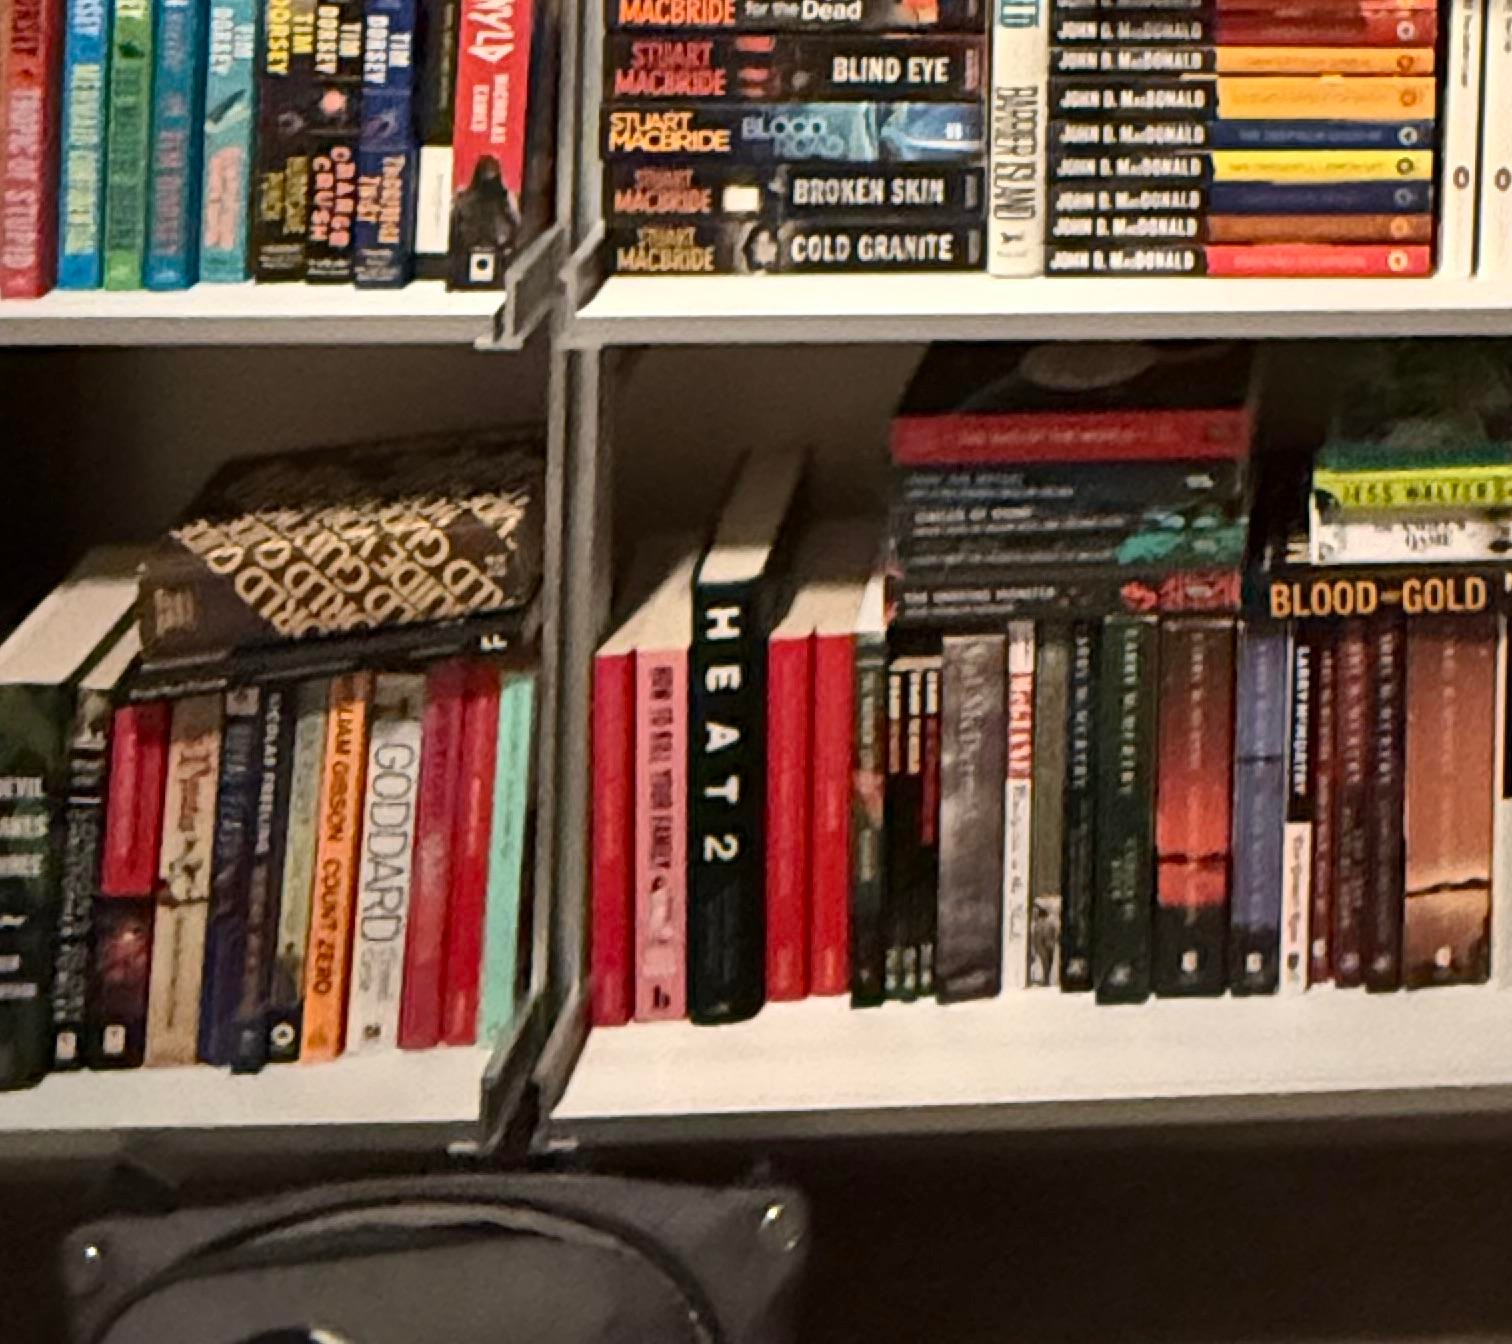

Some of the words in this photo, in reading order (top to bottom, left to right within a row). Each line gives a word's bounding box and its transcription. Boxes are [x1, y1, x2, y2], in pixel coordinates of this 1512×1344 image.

[831, 58, 900, 82] BLIND
[908, 59, 951, 83] EYE
[794, 179, 888, 204] BROKEN
[894, 179, 944, 203] SKIN
[791, 236, 852, 261] COLD
[857, 236, 953, 260] GRANITE
[1271, 582, 1376, 618] BLOOD
[1401, 578, 1487, 614] GOLD
[361, 742, 415, 941] GODDARD
[703, 835, 738, 861] 2
[318, 859, 338, 927] COUNT
[315, 937, 335, 995] ZERO
